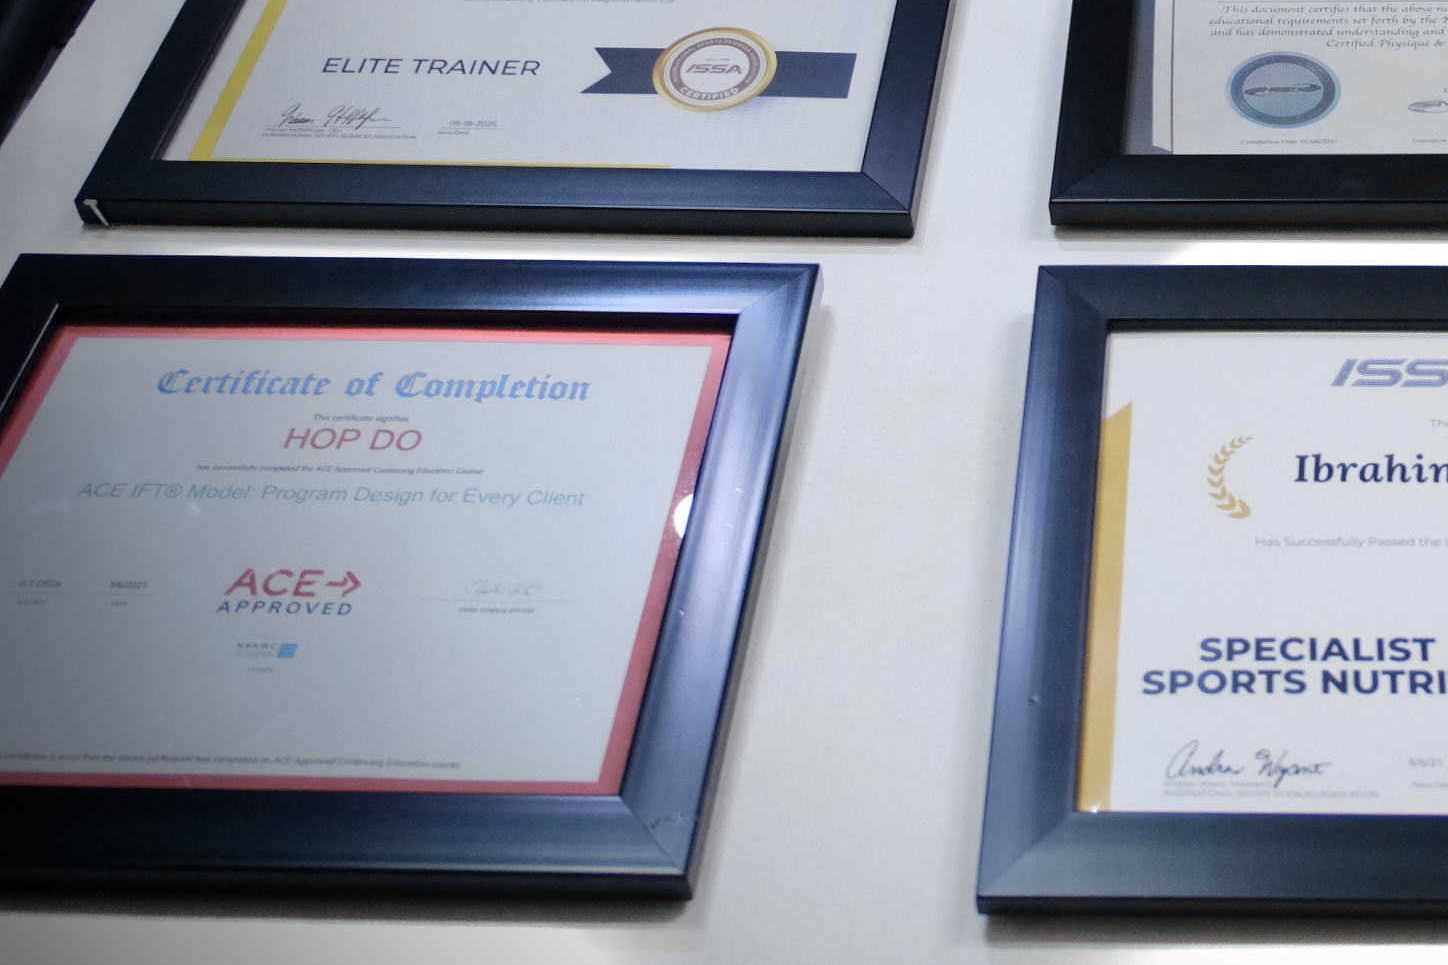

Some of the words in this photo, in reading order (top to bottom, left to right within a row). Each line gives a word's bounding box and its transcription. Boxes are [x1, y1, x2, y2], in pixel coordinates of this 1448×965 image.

[1222, 5, 1249, 14] This
[1251, 4, 1304, 13] document
[1308, 4, 1350, 15] certifies
[1354, 4, 1378, 12] that
[1381, 4, 1398, 12] the
[1401, 4, 1433, 12] above
[1326, 38, 1375, 49] Certified
[1378, 38, 1431, 50] Physique
[1434, 39, 1447, 47] &
[321, 57, 404, 74] ELITE
[412, 58, 541, 76] TRAINER
[685, 63, 743, 74] ISSA
[680, 86, 739, 100] CERTIFIED
[156, 368, 332, 396] Certificate
[343, 371, 385, 397] of
[394, 371, 591, 404] Completion
[313, 413, 331, 421] This
[331, 413, 375, 422] certificate
[375, 415, 410, 424] signifies
[283, 427, 362, 450] HOP
[368, 428, 423, 452] DO
[76, 482, 127, 498] ACE
[188, 484, 255, 501] Model:
[260, 484, 349, 505] Program
[352, 486, 425, 507] Design
[429, 487, 459, 503] for
[461, 487, 522, 509] Every
[526, 489, 585, 506] Client
[1254, 537, 1281, 548] Has
[1283, 535, 1365, 549] Successfully
[1367, 536, 1416, 548] Passed
[1418, 537, 1442, 548] the
[224, 568, 326, 598] ACE
[215, 600, 353, 616] APPROVED
[1200, 636, 1436, 663] SPECIALIST
[1143, 669, 1307, 695] SPORTS
